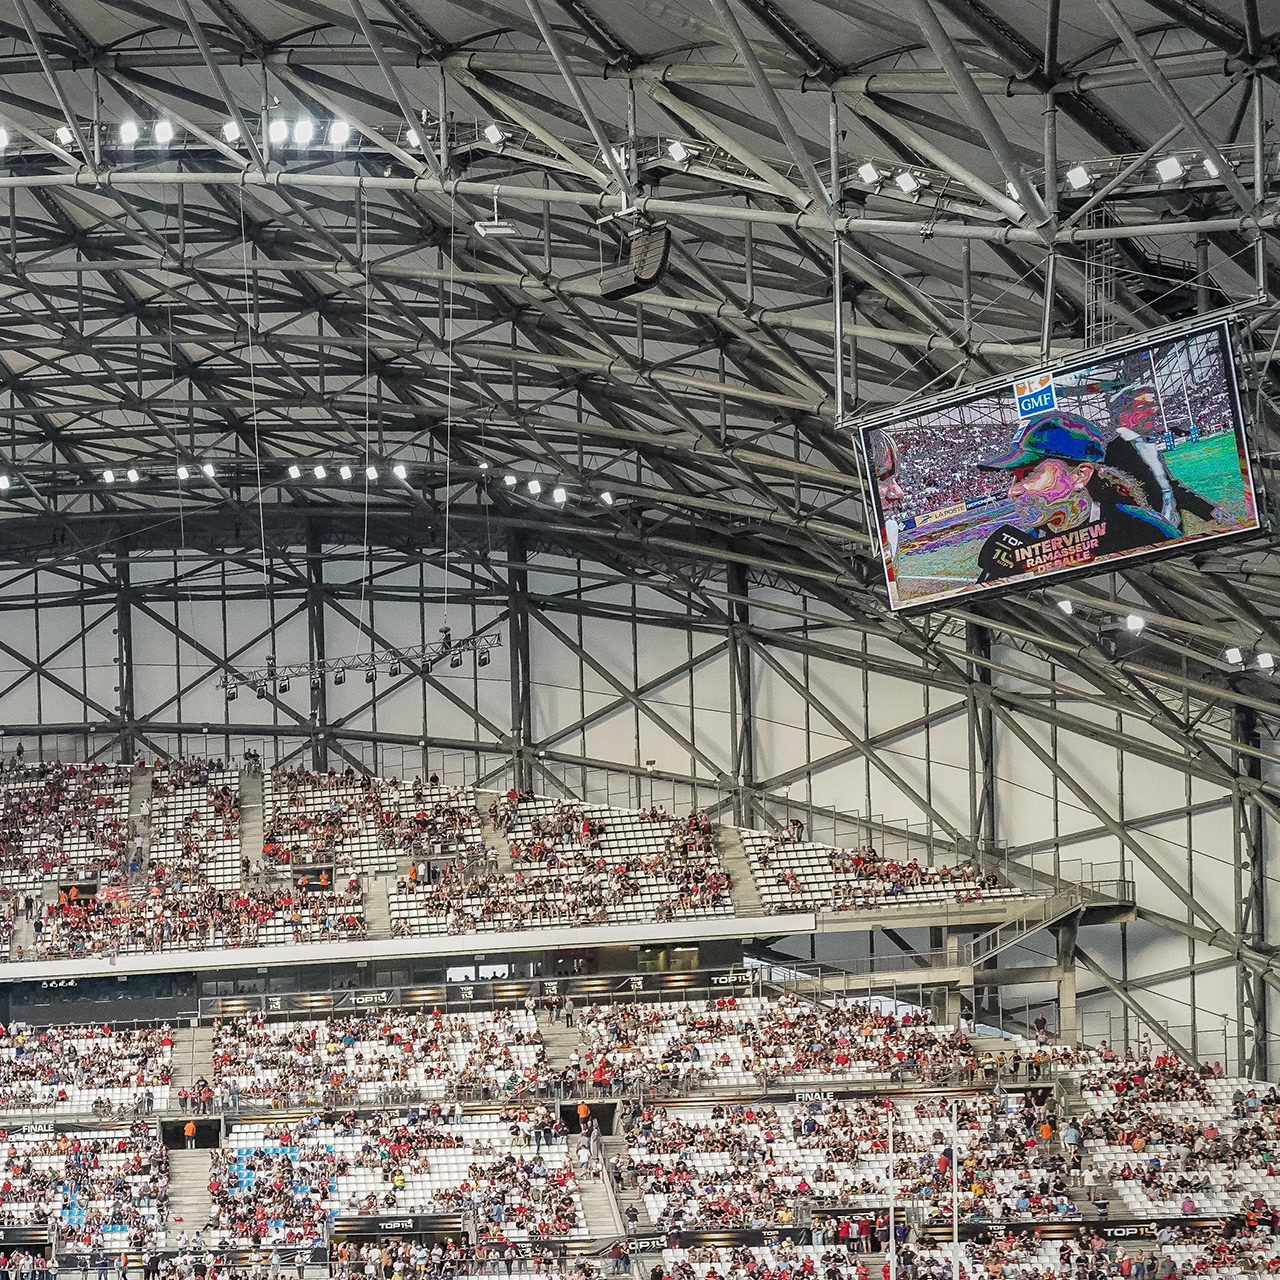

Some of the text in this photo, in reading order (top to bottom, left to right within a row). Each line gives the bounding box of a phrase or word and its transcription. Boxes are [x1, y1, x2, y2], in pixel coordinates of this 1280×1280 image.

[1020, 393, 1051, 411] GMF
[1015, 522, 1107, 561] INTERVIEW
[1026, 539, 1099, 568] RAMASSEUR
[350, 994, 387, 1004] TOP14
[795, 1092, 834, 1101] FINALE
[22, 1124, 54, 1133] FINALE
[379, 1219, 414, 1230] TOP14
[1104, 1225, 1157, 1238] TOP14
[629, 1236, 667, 1249] OP14
